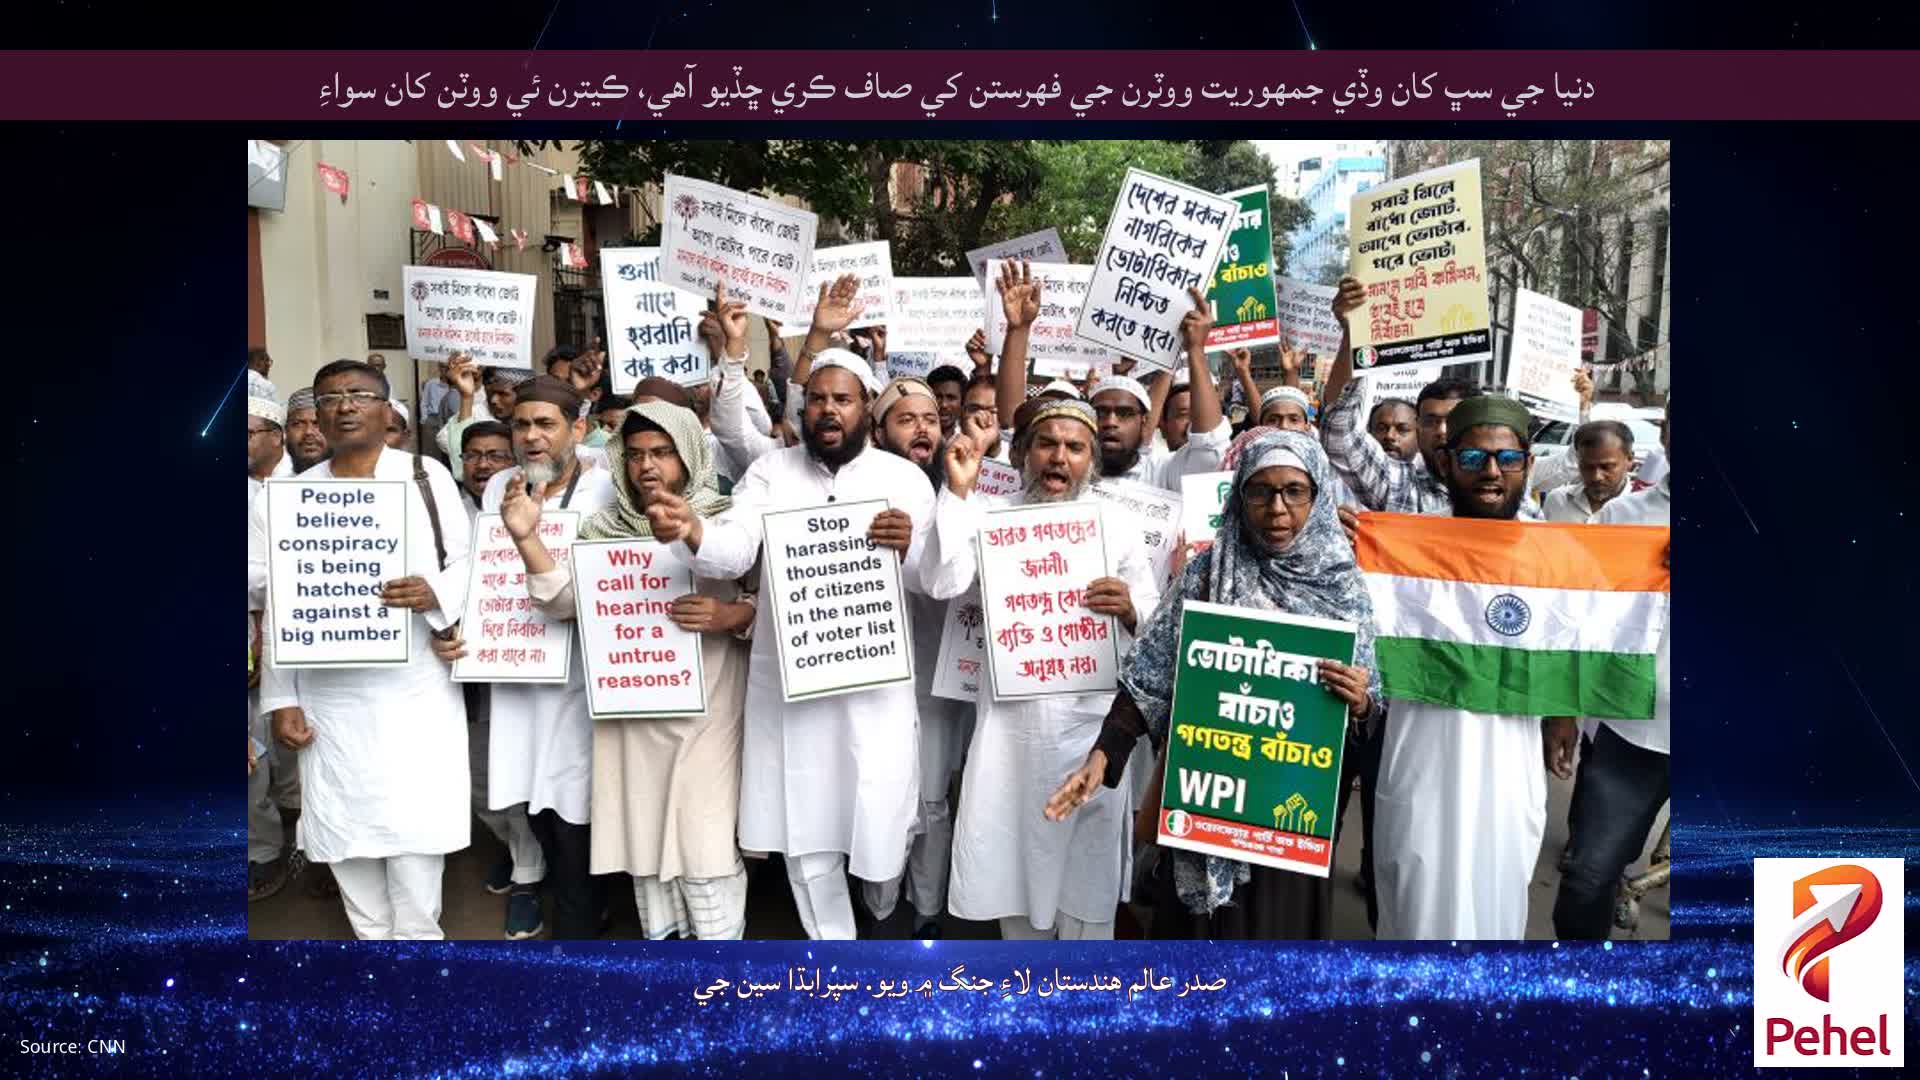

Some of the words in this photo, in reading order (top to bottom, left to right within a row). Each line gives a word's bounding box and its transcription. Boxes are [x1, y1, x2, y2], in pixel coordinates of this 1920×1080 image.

[1128, 182, 1179, 215] দেশের
[1182, 199, 1228, 230] সকল
[1370, 188, 1409, 213] সবাই
[1413, 180, 1455, 201] মিলে
[1124, 216, 1207, 258] নাগরিকের
[1358, 233, 1401, 254] আগে
[1221, 262, 1268, 284] বাঁচাও
[1372, 253, 1405, 272] পরে
[634, 291, 677, 318] নামে
[1115, 276, 1170, 315] নিশ্চিত
[625, 316, 692, 352] হয়রানি
[1091, 307, 1138, 341] করতে
[992, 470, 1015, 484] are
[301, 488, 375, 507] People
[976, 483, 999, 495] oud
[296, 512, 380, 529] believe,
[807, 516, 849, 534] Stop
[278, 537, 398, 554] conspiracy
[785, 535, 877, 559] harassing
[984, 526, 1027, 547] ভারত
[297, 559, 315, 575] is
[322, 559, 381, 578] being
[607, 549, 653, 569] Why
[786, 557, 882, 582] thousands
[296, 581, 382, 598] hatched
[597, 575, 634, 592] call
[640, 574, 671, 590] for
[789, 585, 808, 603] of
[814, 578, 885, 600] citizens
[292, 604, 371, 623] against
[377, 606, 389, 619] a
[788, 609, 803, 626] in
[809, 605, 838, 622] the
[843, 601, 893, 619] name
[281, 627, 315, 646] big
[321, 626, 401, 642] number
[615, 623, 648, 640] for
[651, 626, 664, 639] a
[791, 630, 809, 648] of
[816, 626, 862, 644] voter
[868, 618, 896, 636] list
[996, 621, 1035, 652] ব্যক্তি
[1040, 626, 1053, 643] ও
[609, 649, 676, 665] untrue
[795, 641, 896, 669] correction!
[1187, 634, 1324, 686] ভোটাধিকা
[598, 670, 692, 689] reasons?
[1217, 681, 1296, 730] বাঁচাও
[1176, 723, 1253, 761] গণতন্ত্র
[1260, 731, 1334, 769] বাঁচাও
[1178, 767, 1247, 815] WPI
